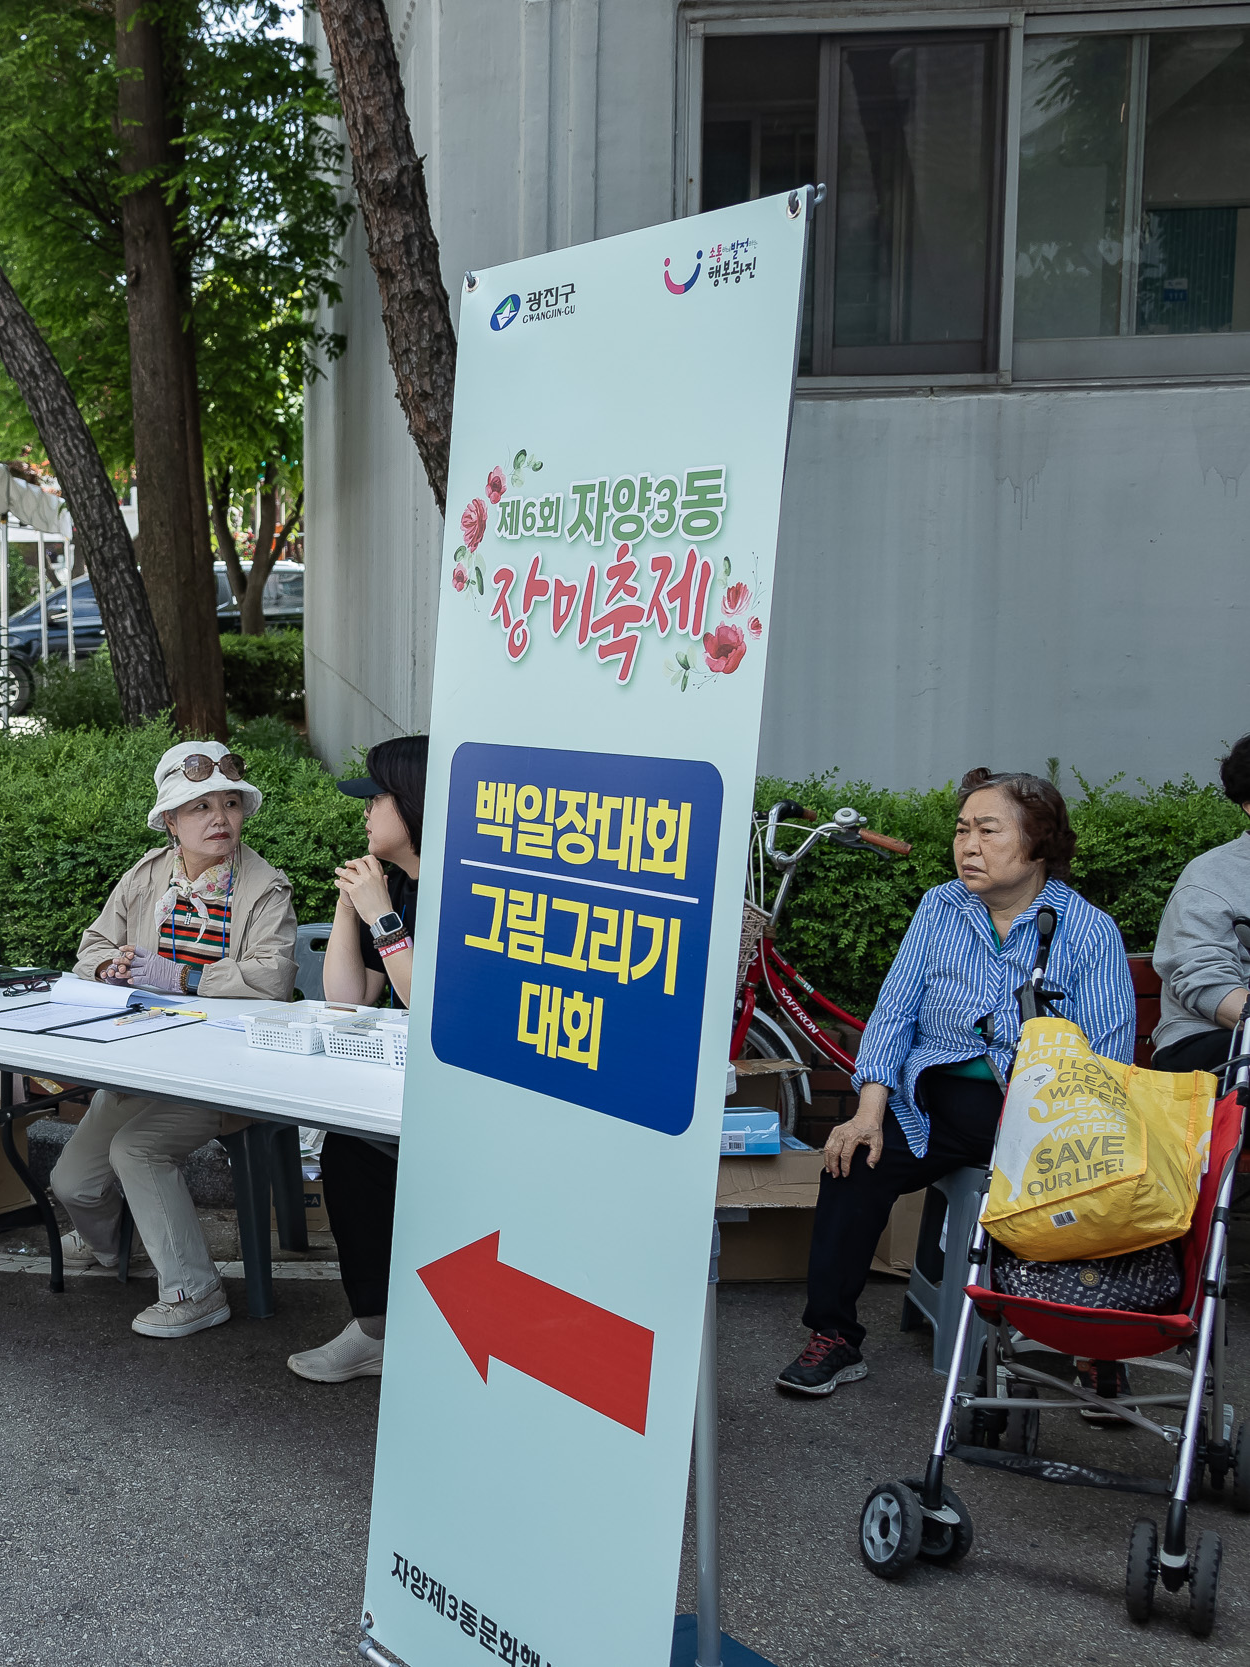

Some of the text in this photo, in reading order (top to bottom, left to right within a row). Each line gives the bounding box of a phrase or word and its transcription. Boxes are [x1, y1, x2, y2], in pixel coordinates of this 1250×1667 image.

[708, 257, 756, 287] 행복광진
[522, 305, 576, 324] GWANGJIN-GU
[525, 283, 576, 312] 광진구
[497, 467, 725, 542] 제6회 자양3동
[490, 545, 713, 682] 장미축제
[475, 781, 692, 880] 백일장대회
[464, 883, 682, 996] 그림그리기
[516, 981, 604, 1072] 대회
[778, 987, 820, 1034] SAFFRON
[1028, 1046, 1083, 1064] CUTE.
[1058, 1058, 1064, 1070] I
[1048, 1083, 1131, 1112] WATER.
[1057, 1071, 1127, 1100] CLEAN
[1050, 1121, 1127, 1142] WATER!
[1076, 1108, 1127, 1124] SAVE
[1035, 1135, 1126, 1175] SAVE
[1026, 1158, 1125, 1197] OUR LIFE!
[390, 1550, 552, 1667] 자양제3동문화행
